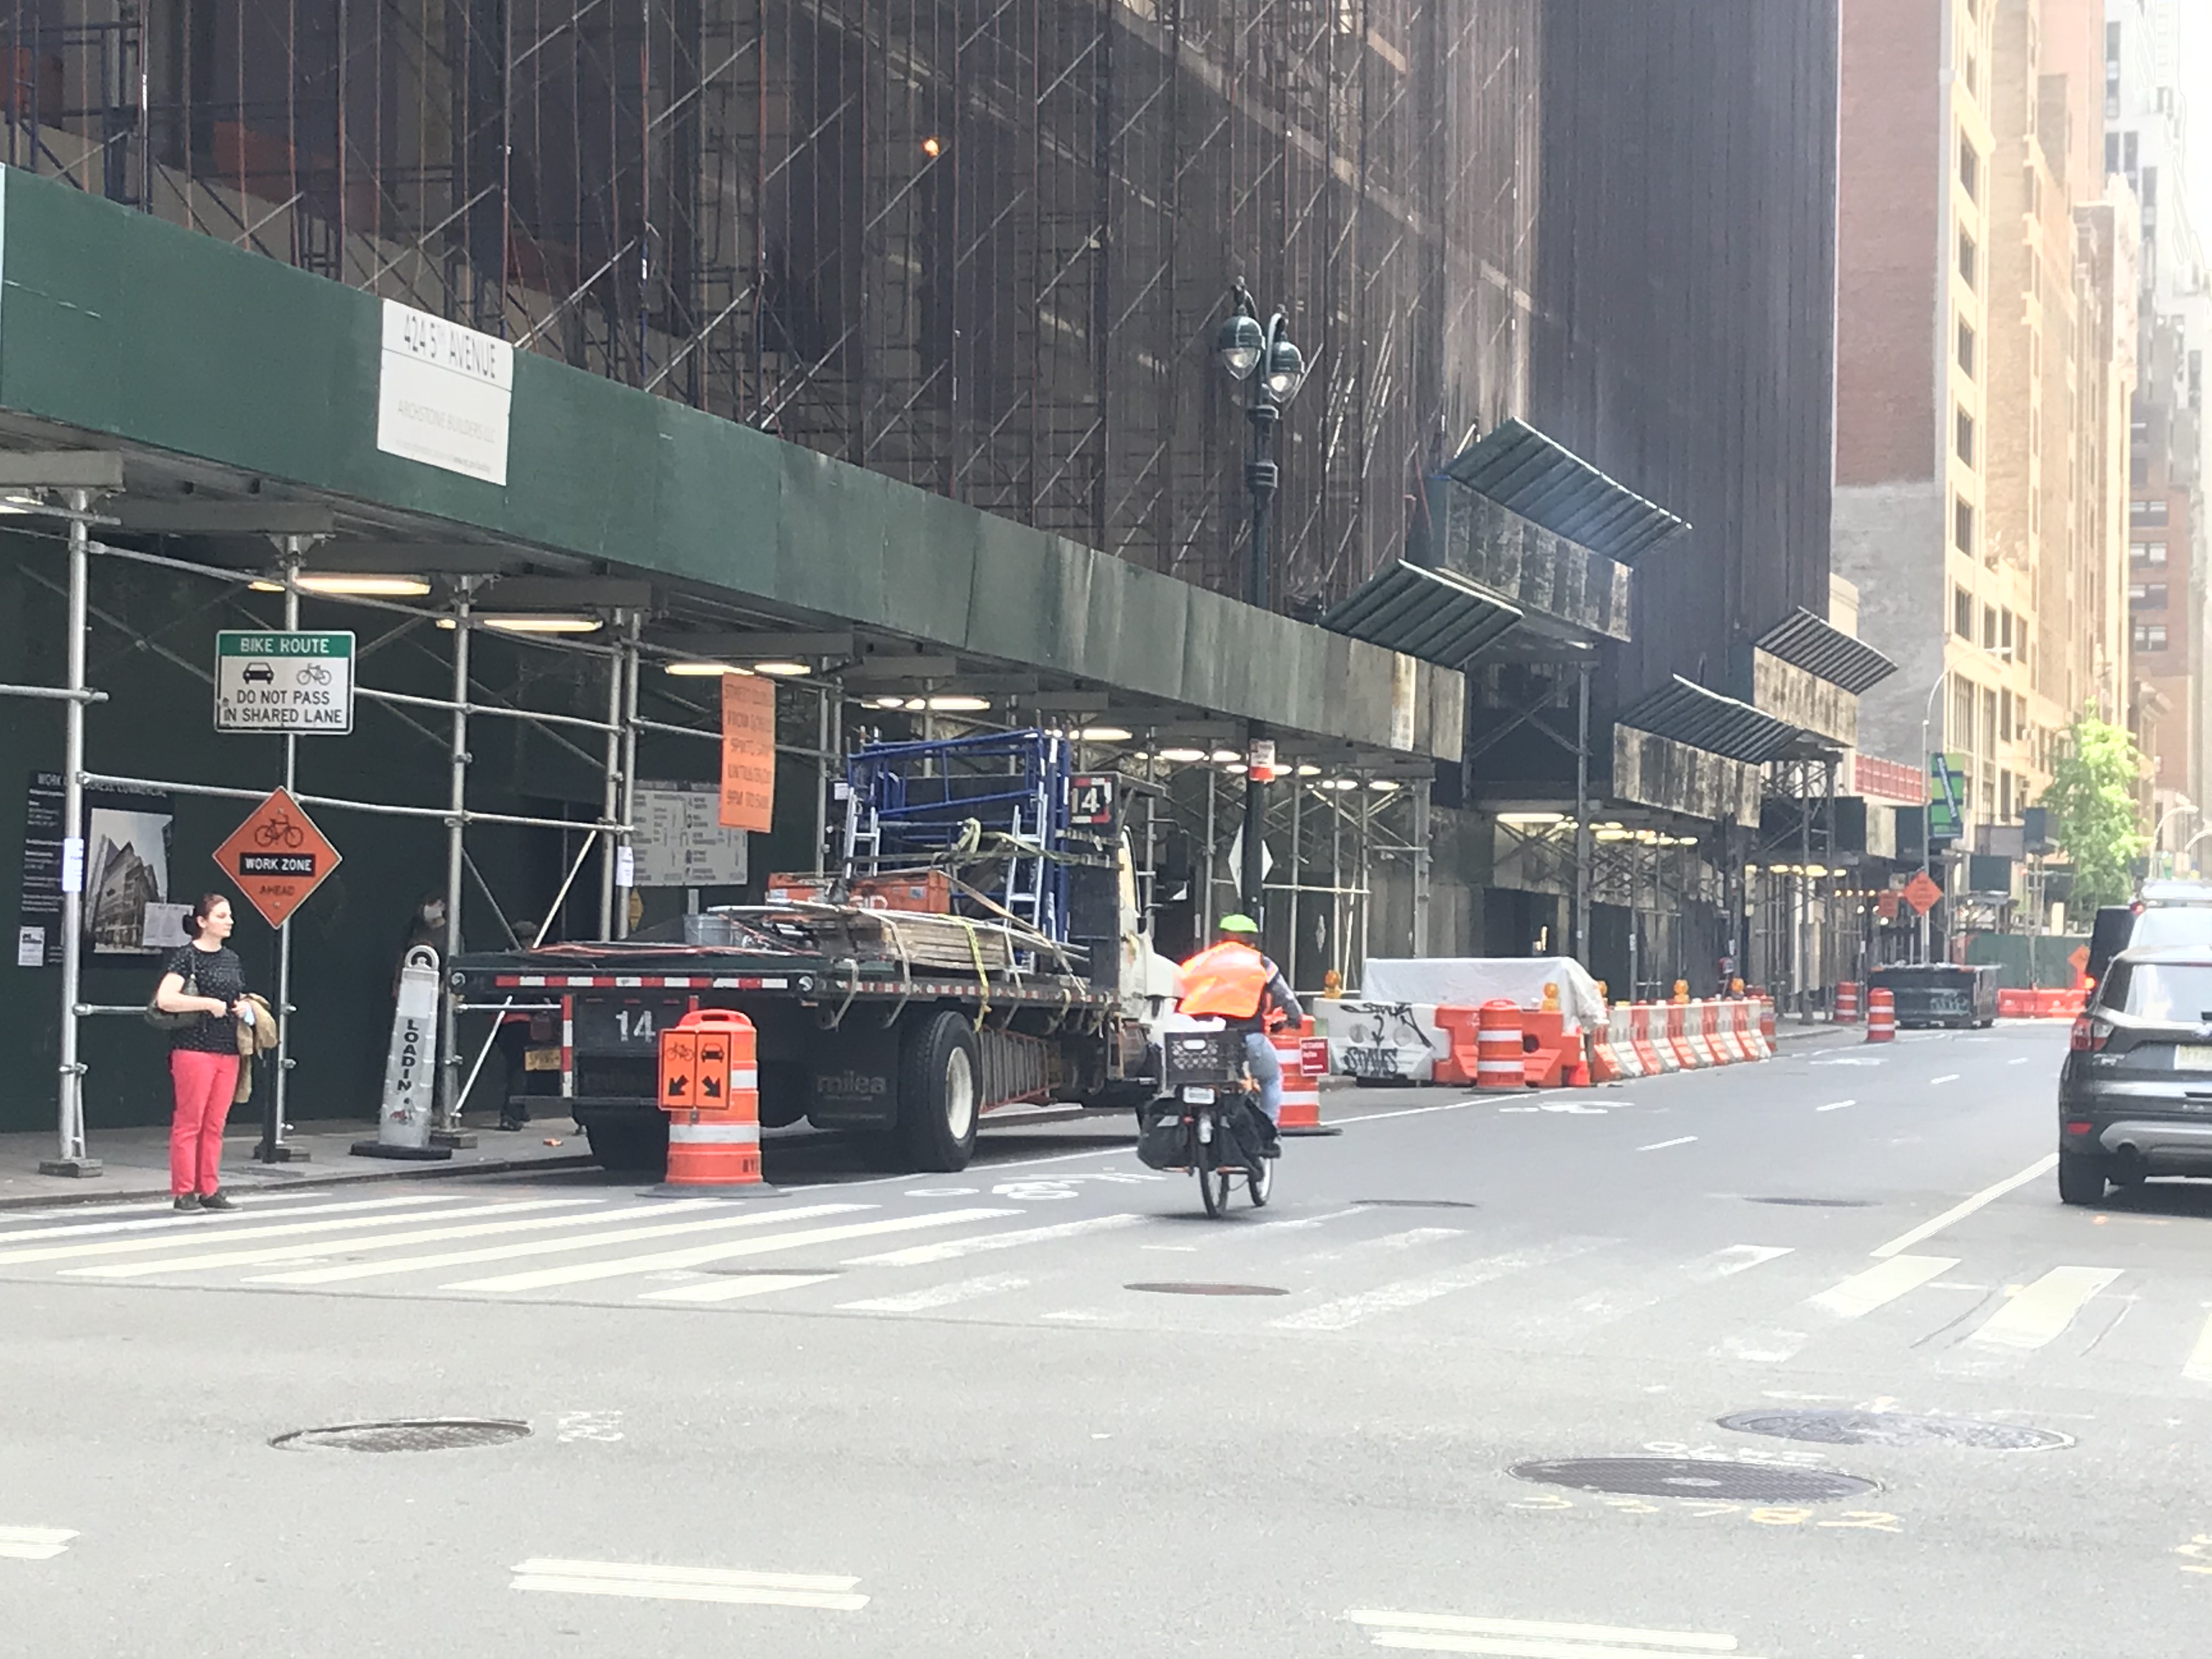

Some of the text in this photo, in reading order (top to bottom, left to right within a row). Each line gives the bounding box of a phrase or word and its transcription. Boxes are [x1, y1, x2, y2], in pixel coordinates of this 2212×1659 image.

[404, 314, 426, 356] 424
[449, 330, 495, 379] AVENUE
[240, 638, 330, 653] BIKE ROUTE
[237, 690, 330, 705] DO NOT PASS
[224, 708, 342, 723] IN SHARED LANE
[1070, 786, 1101, 812] 14
[245, 857, 312, 871] WORK ZONE
[259, 885, 295, 896] AHEAD
[616, 1010, 656, 1043] 14
[397, 1019, 419, 1104] LOADIN
[816, 1069, 886, 1094] milea
